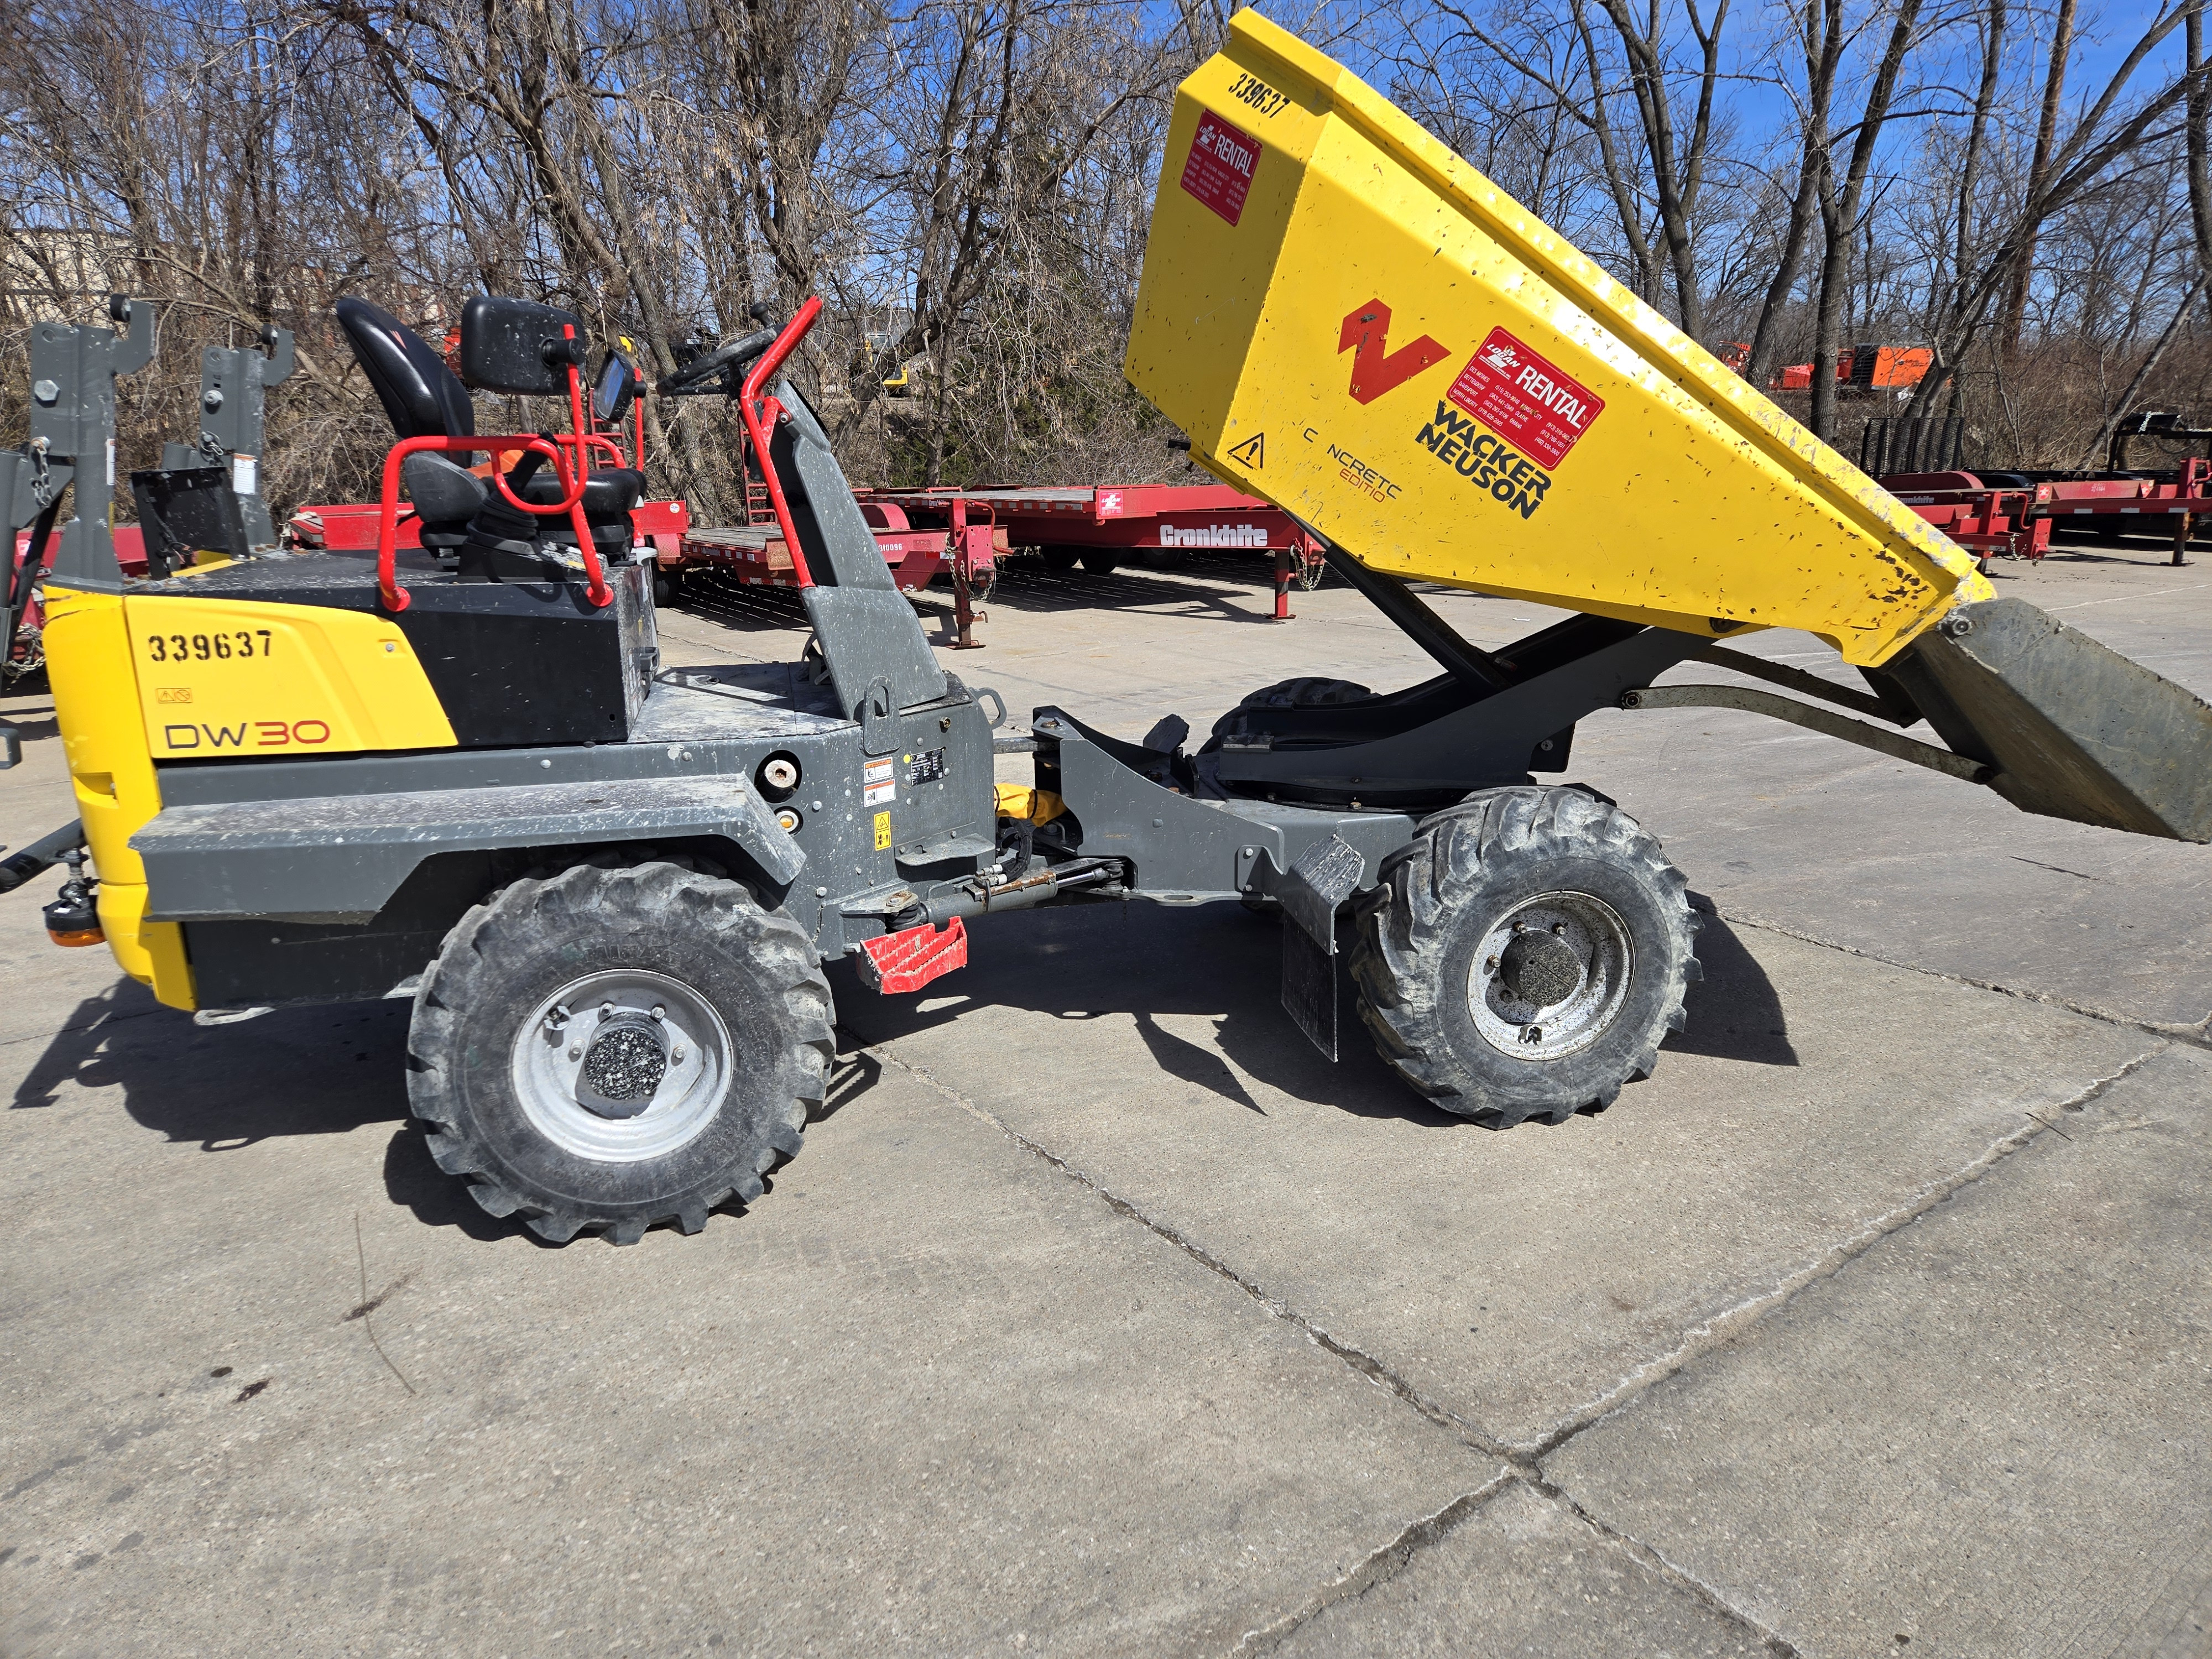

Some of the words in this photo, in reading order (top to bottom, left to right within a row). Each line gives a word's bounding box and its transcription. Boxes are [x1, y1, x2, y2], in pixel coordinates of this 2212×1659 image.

[1228, 72, 1291, 118] 339637
[1199, 126, 1217, 140] LOGAN
[1214, 134, 1253, 178] RENTAL
[1486, 343, 1521, 368] LOGAN
[1458, 381, 1478, 397] DAVENPORT
[1515, 364, 1588, 430] RENTAL
[1434, 399, 1552, 501] WACKER
[1415, 422, 1540, 519] NEUSON
[1160, 524, 1267, 546] Cronkhite
[148, 629, 273, 662] 339637
[165, 719, 331, 749] DW30
